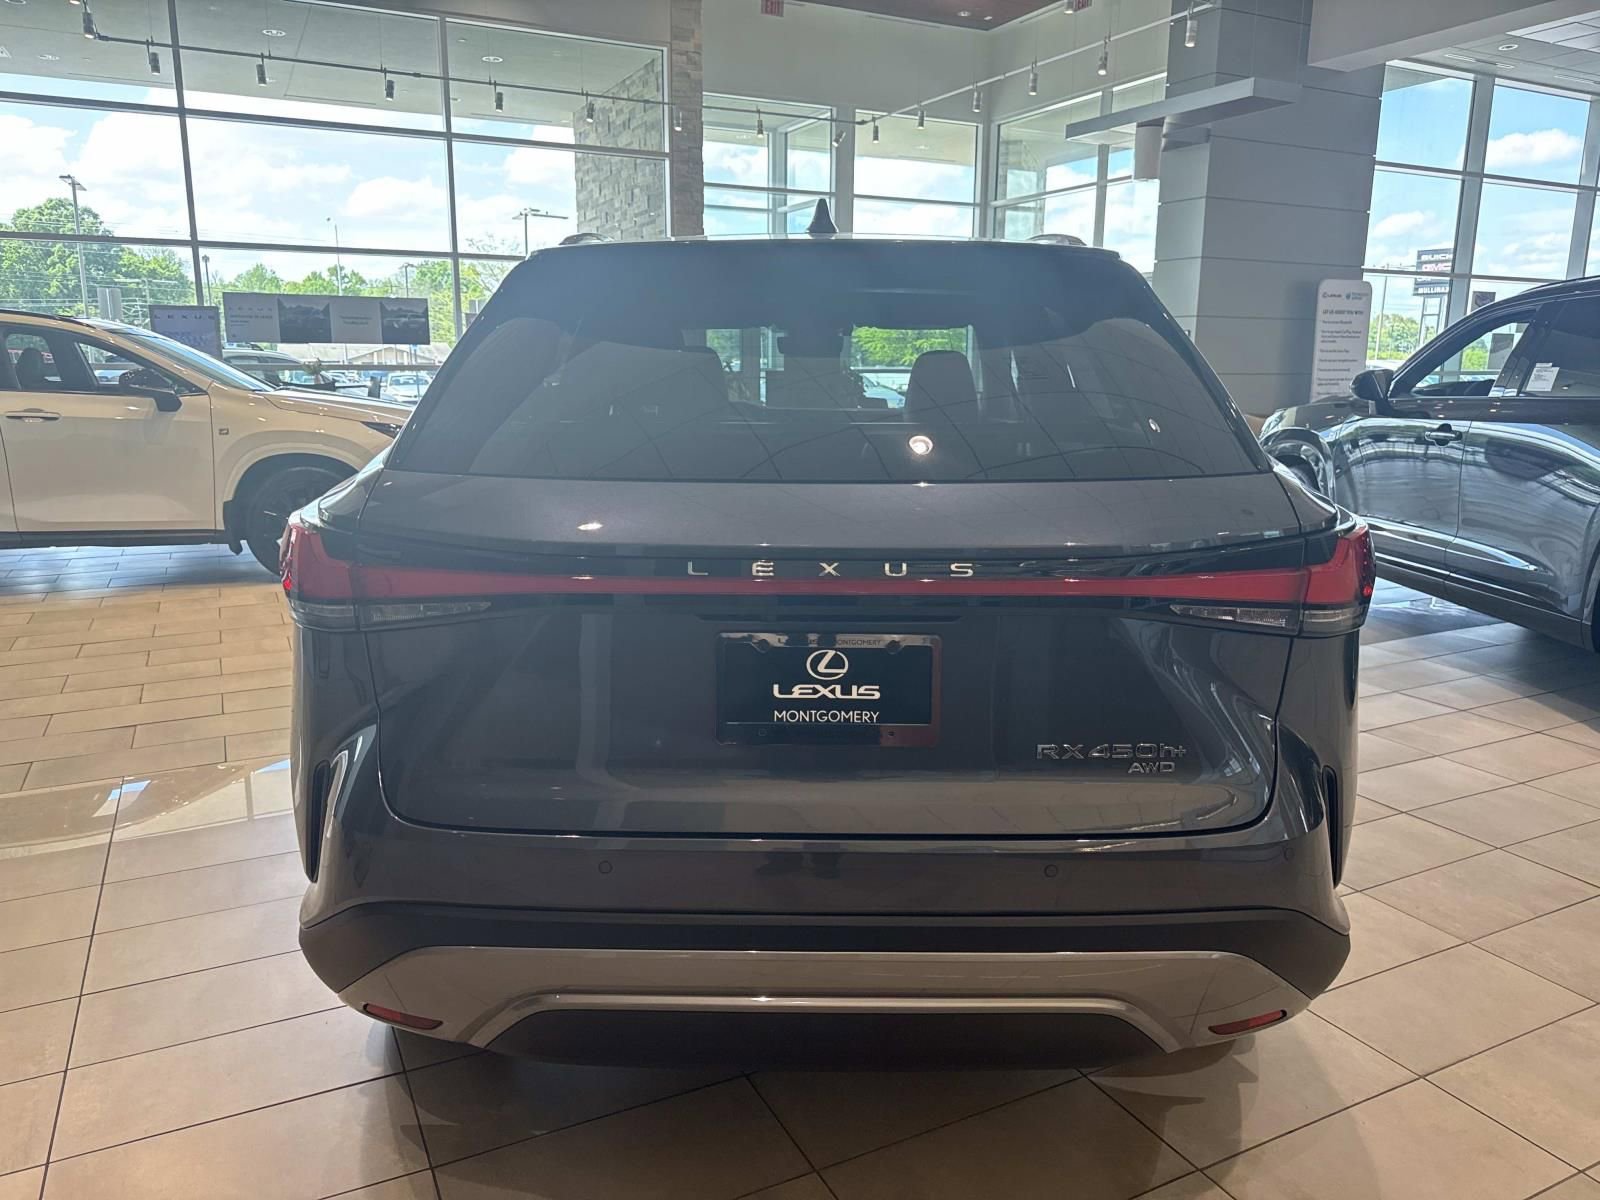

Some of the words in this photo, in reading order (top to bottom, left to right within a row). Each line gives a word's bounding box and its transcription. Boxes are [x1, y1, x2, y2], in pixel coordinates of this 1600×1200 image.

[687, 561, 974, 577] LEXUS
[773, 684, 881, 700] LEXUS
[774, 710, 880, 723] MONTGOMERY
[1127, 761, 1175, 774] AWD
